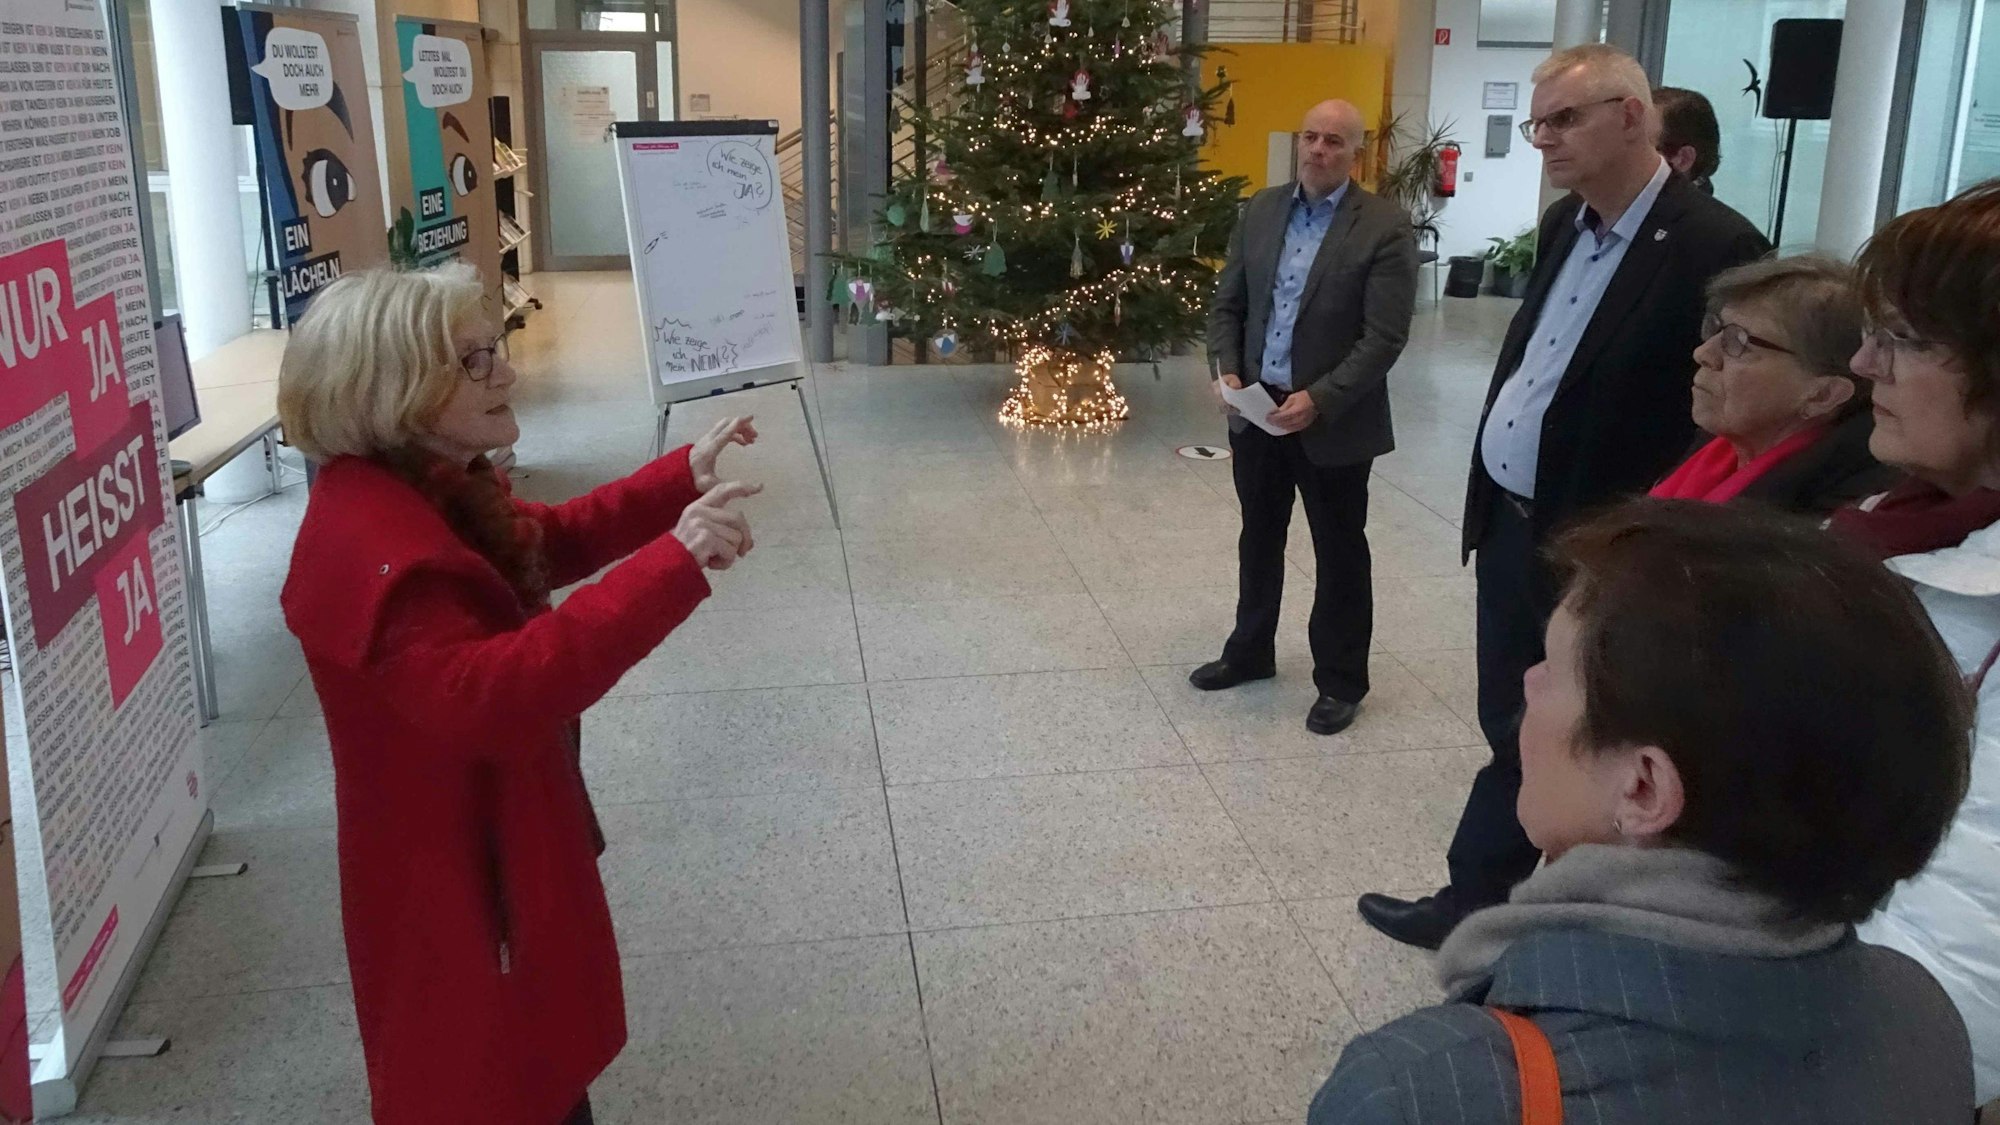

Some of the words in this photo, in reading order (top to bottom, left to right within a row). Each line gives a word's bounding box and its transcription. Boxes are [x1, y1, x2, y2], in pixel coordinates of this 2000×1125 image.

[272, 44, 284, 58] DU
[284, 44, 318, 58] WOLLTEST
[418, 50, 440, 62] LETZTES
[91, 62, 110, 72] NACH
[283, 64, 304, 77] DOCH
[306, 64, 324, 77] AUCH
[433, 66, 458, 78] WOLLTEST
[92, 79, 113, 89] HEUTE
[299, 83, 320, 96] MEHR
[432, 84, 448, 95] DOCH
[448, 84, 463, 94] AUCH
[96, 111, 118, 122] UNTER
[104, 126, 120, 138] JOB
[105, 142, 122, 154] KEIN
[107, 157, 125, 171] KEIN
[720, 148, 739, 164] Wie
[738, 156, 763, 176] zeige
[712, 160, 724, 172] ich
[726, 168, 748, 181] mein
[108, 174, 127, 187] MEIN
[108, 189, 130, 204] NACH
[422, 192, 444, 216] EINE
[109, 204, 133, 222] HEUTE
[123, 220, 135, 233] JA
[284, 223, 310, 251] EIN
[418, 220, 468, 253] BEZIEHUNG
[127, 250, 139, 264] JA
[120, 265, 141, 284] MEIN
[282, 258, 341, 298] LÄCHELN
[124, 282, 144, 297] KEIN
[125, 298, 146, 313] MEIN
[125, 314, 147, 329] NACH
[125, 328, 150, 344] HEUTE
[663, 328, 681, 346] Wie
[685, 336, 711, 352] zeige
[81, 319, 121, 402] JA
[672, 346, 688, 360] ich
[142, 372, 156, 387] IST
[42, 434, 145, 592] HEISST
[161, 532, 176, 549] DIR
[116, 556, 153, 646] JA
